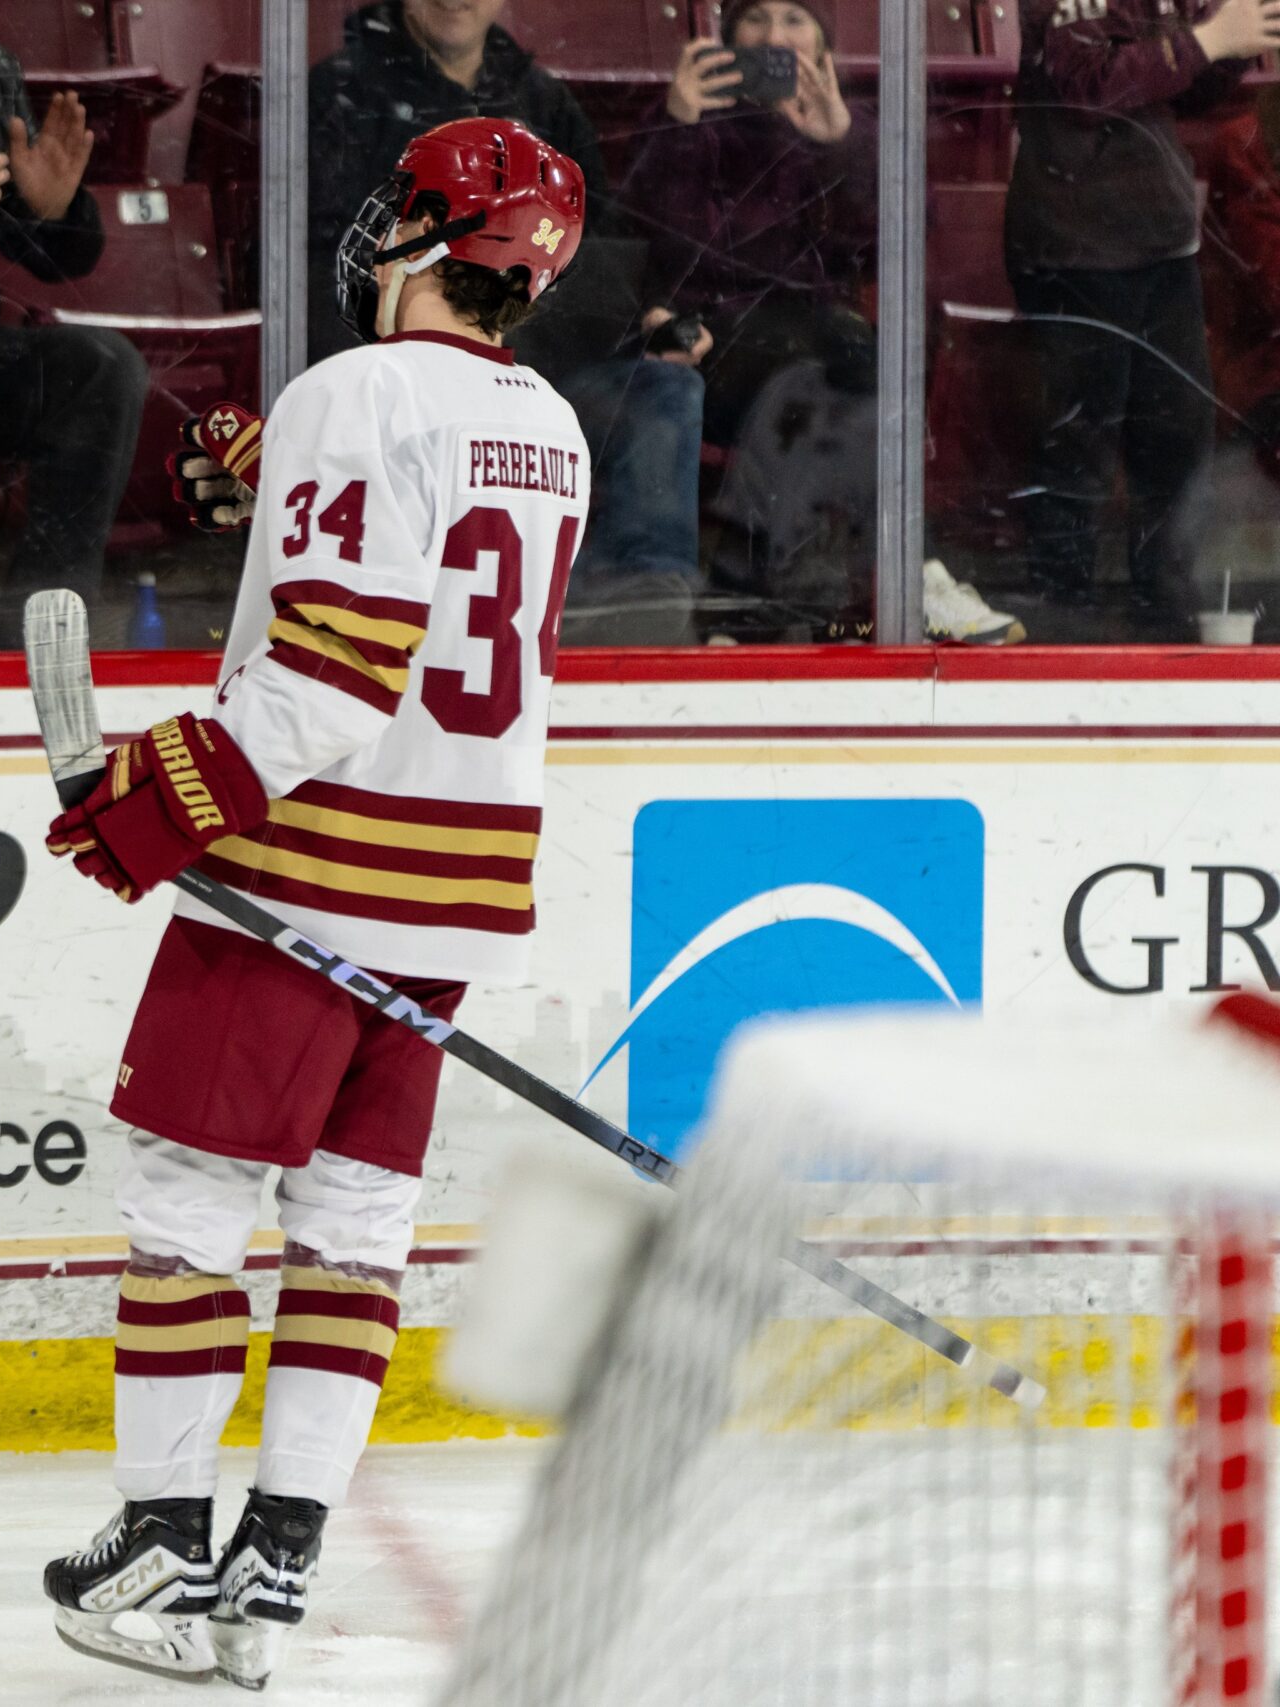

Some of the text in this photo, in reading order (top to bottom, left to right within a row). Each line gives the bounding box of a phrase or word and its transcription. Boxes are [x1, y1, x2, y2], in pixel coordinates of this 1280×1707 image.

[138, 196, 152, 221] 5
[531, 217, 565, 255] 34
[282, 480, 367, 564] 34
[421, 506, 580, 739] 34
[151, 716, 225, 831] ARRIOR
[273, 927, 458, 1046] CCM
[93, 1551, 164, 1611] CCM
